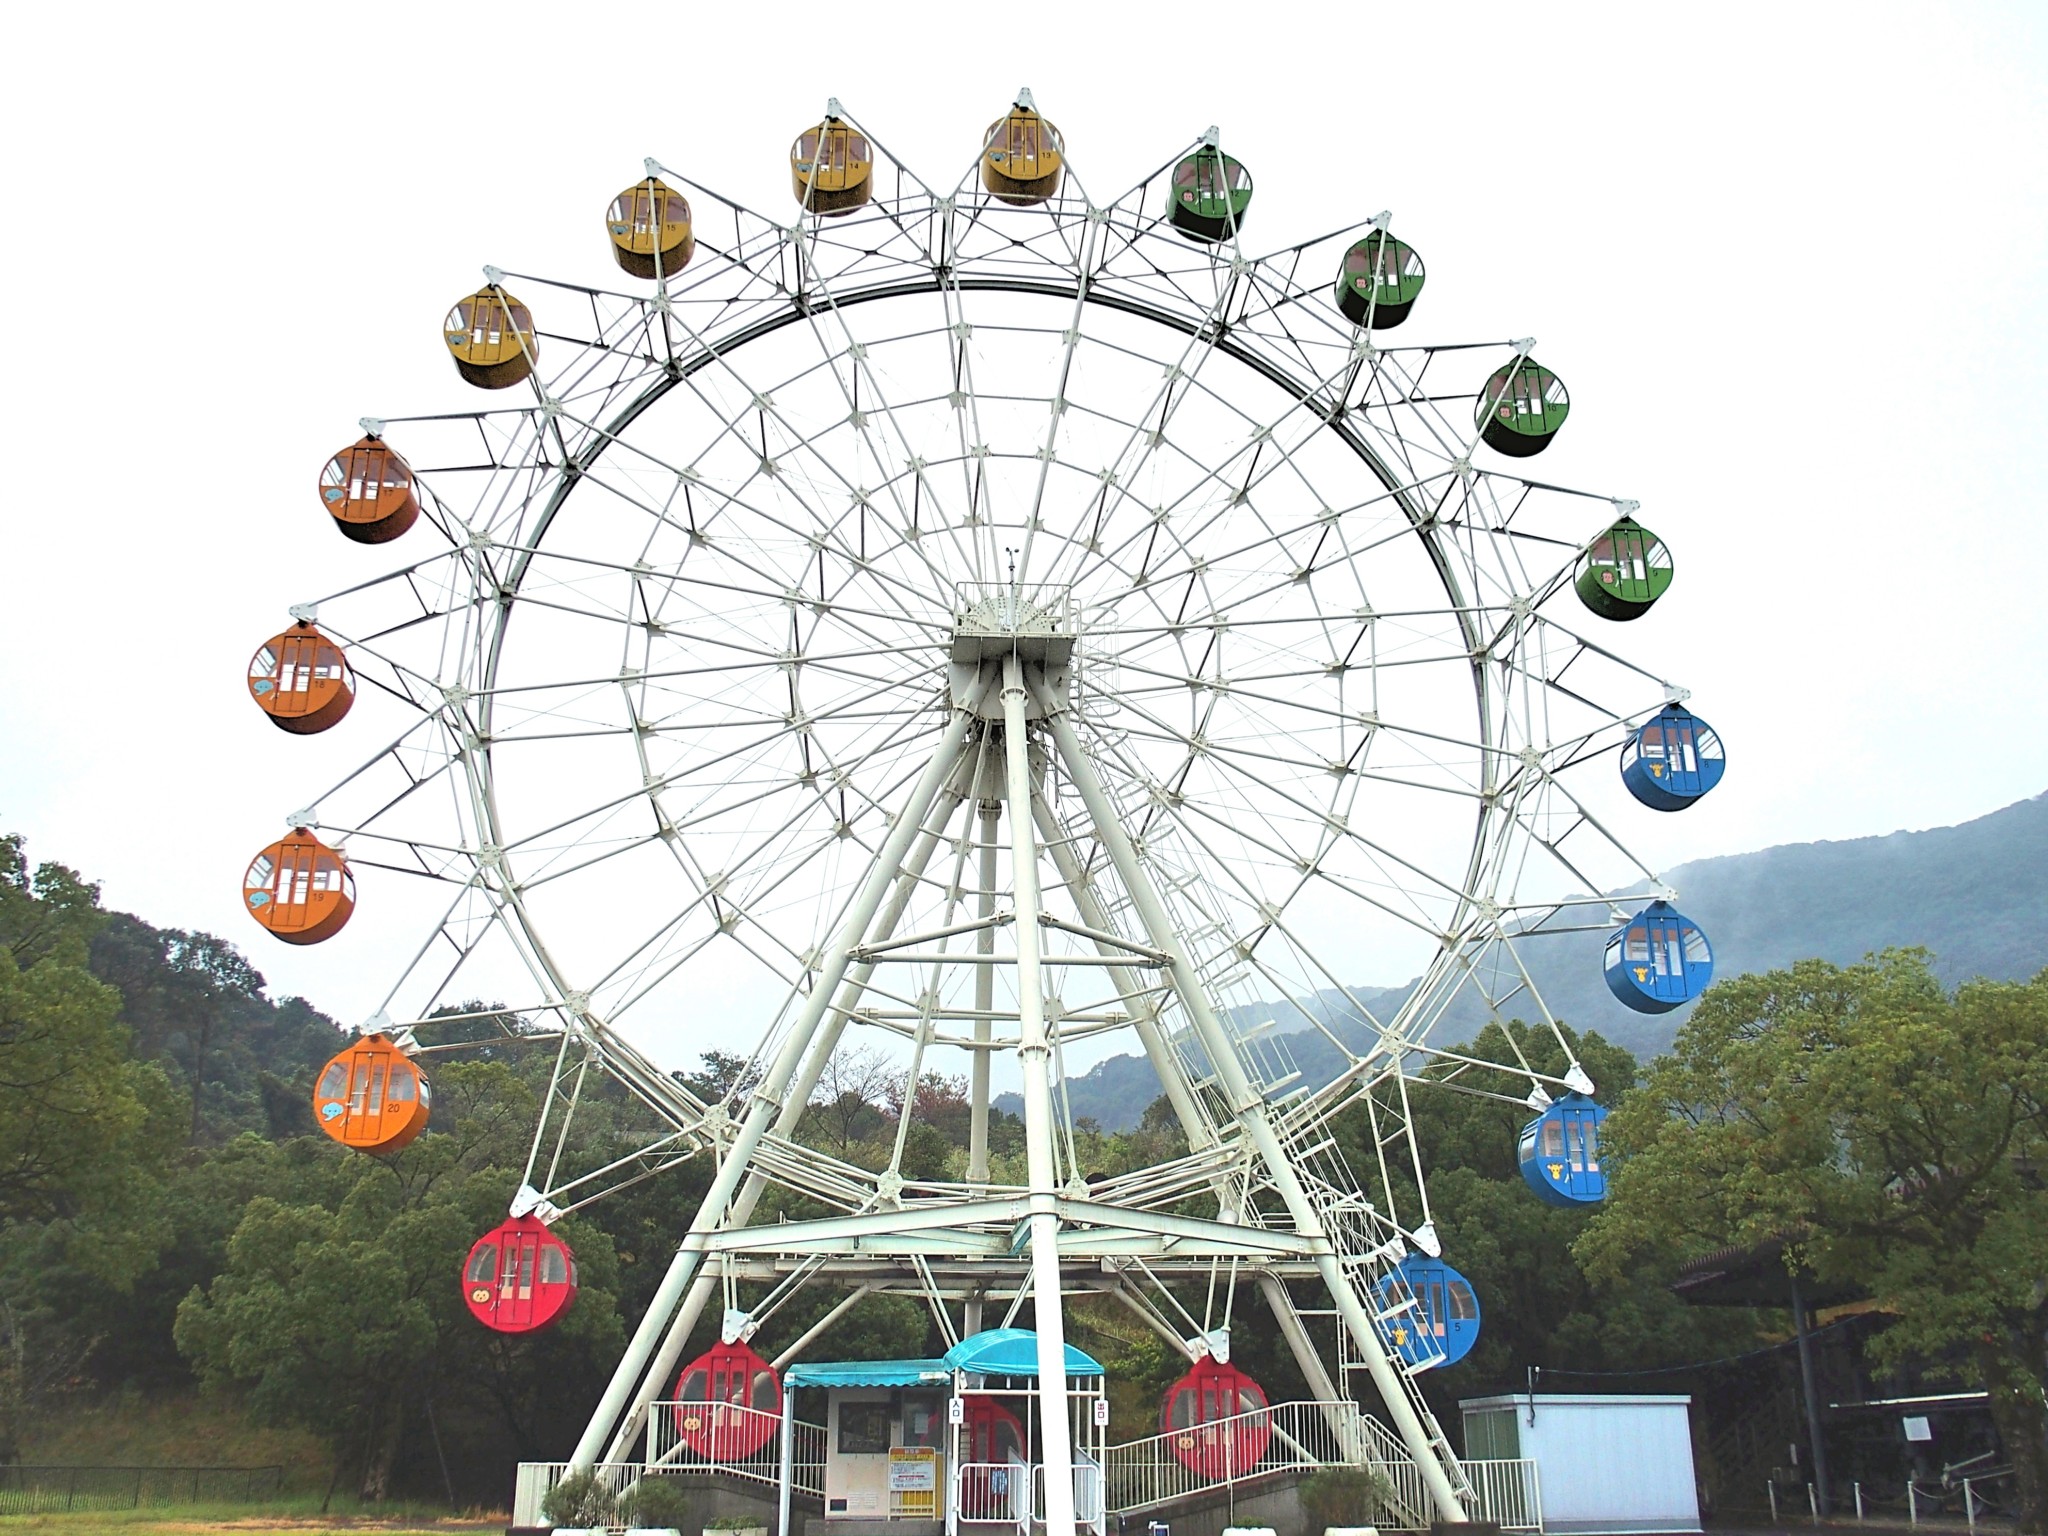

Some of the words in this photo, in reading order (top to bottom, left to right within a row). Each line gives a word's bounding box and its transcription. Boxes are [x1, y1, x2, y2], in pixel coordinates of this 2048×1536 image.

[314, 893, 323, 901] 19
[388, 1103, 400, 1112] 20
[952, 1400, 961, 1417] 入口
[1097, 1402, 1105, 1419] 出口
